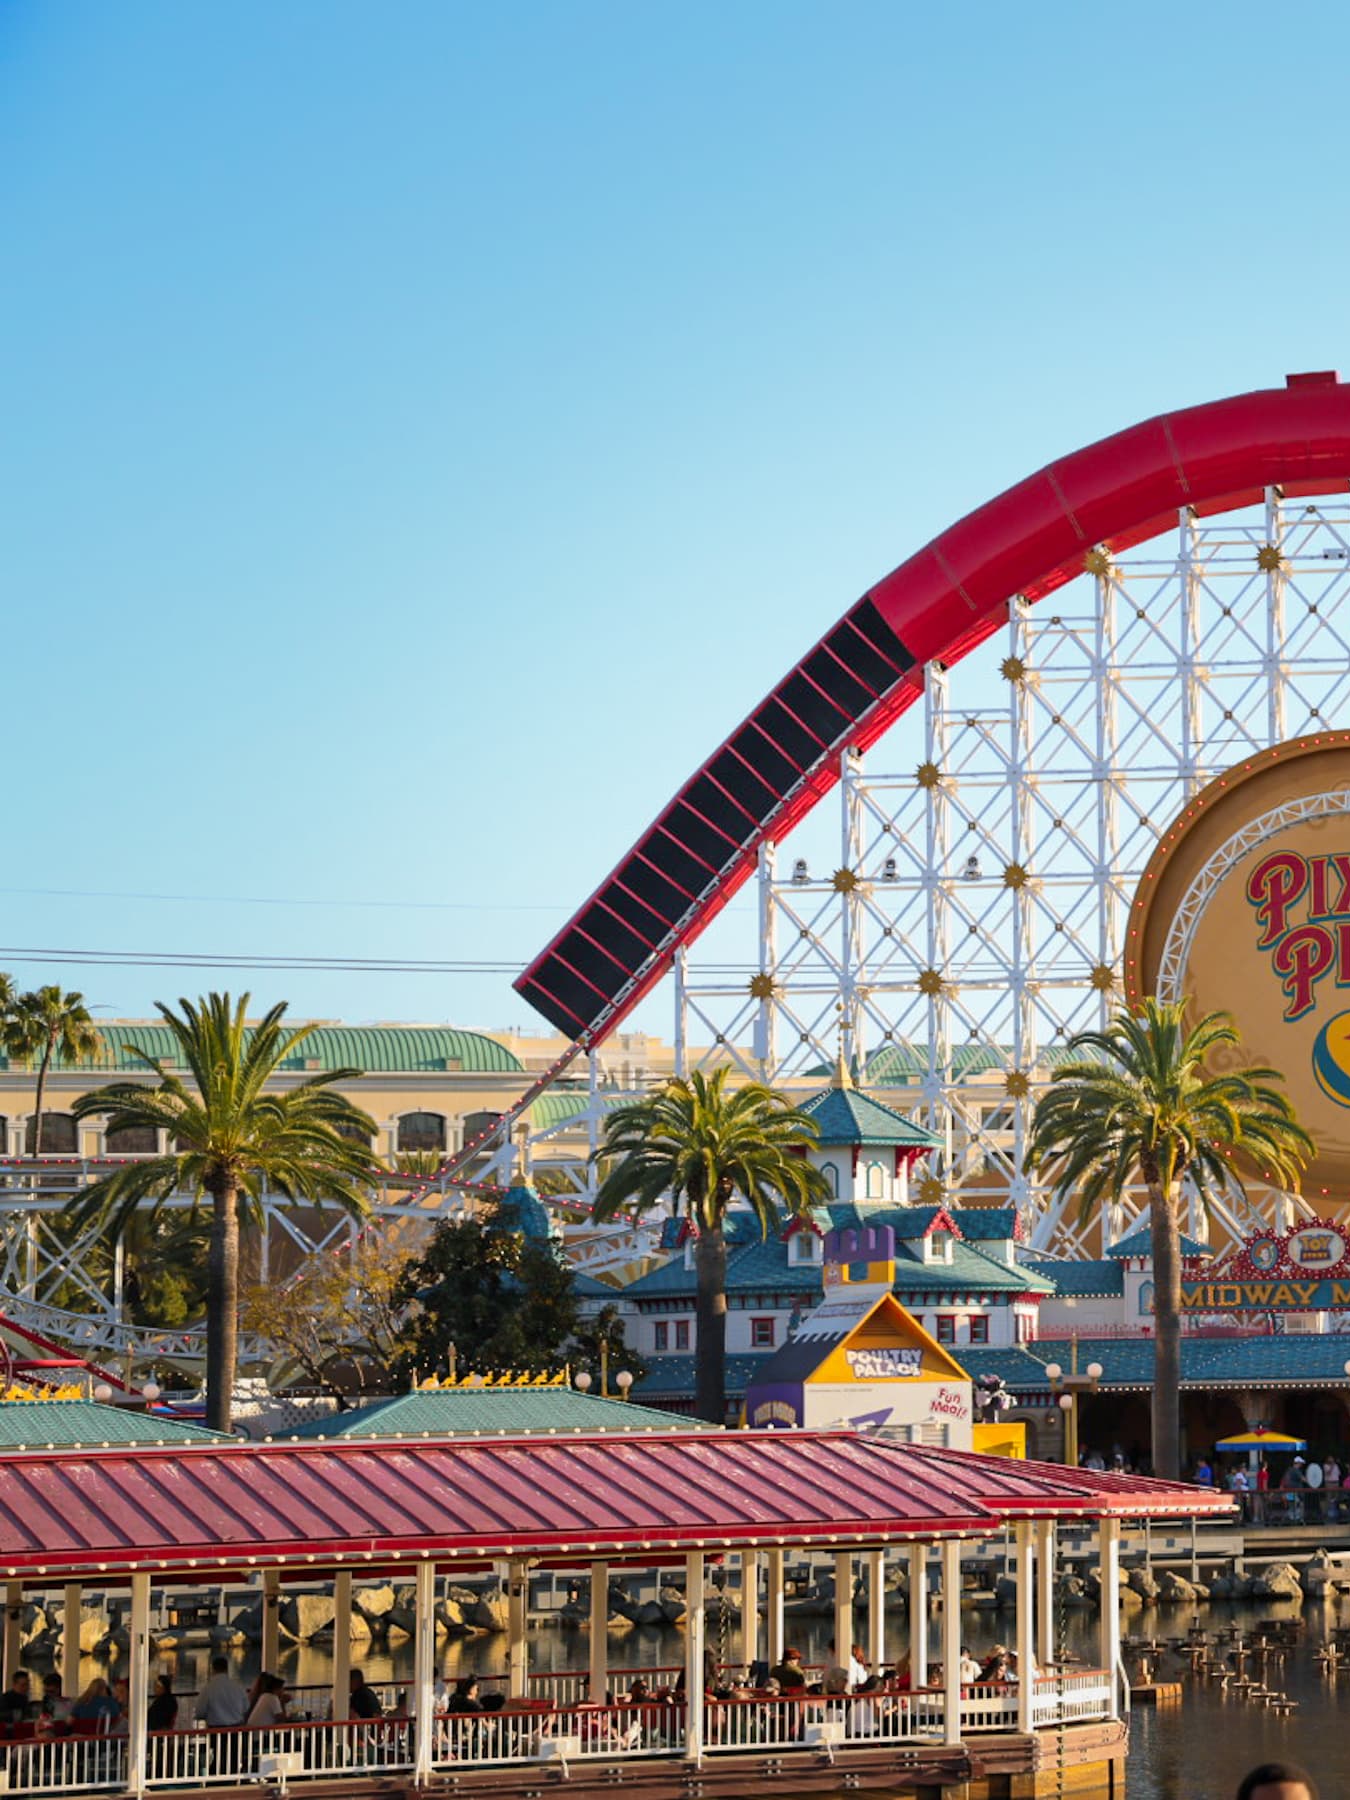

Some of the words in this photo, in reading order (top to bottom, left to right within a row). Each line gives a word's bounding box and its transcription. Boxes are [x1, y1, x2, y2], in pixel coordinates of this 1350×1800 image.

[1180, 1283, 1320, 1307] MIDWAY
[846, 1349, 922, 1364] POULTRY
[854, 1359, 921, 1377] PALACE
[939, 1388, 961, 1404] Fun
